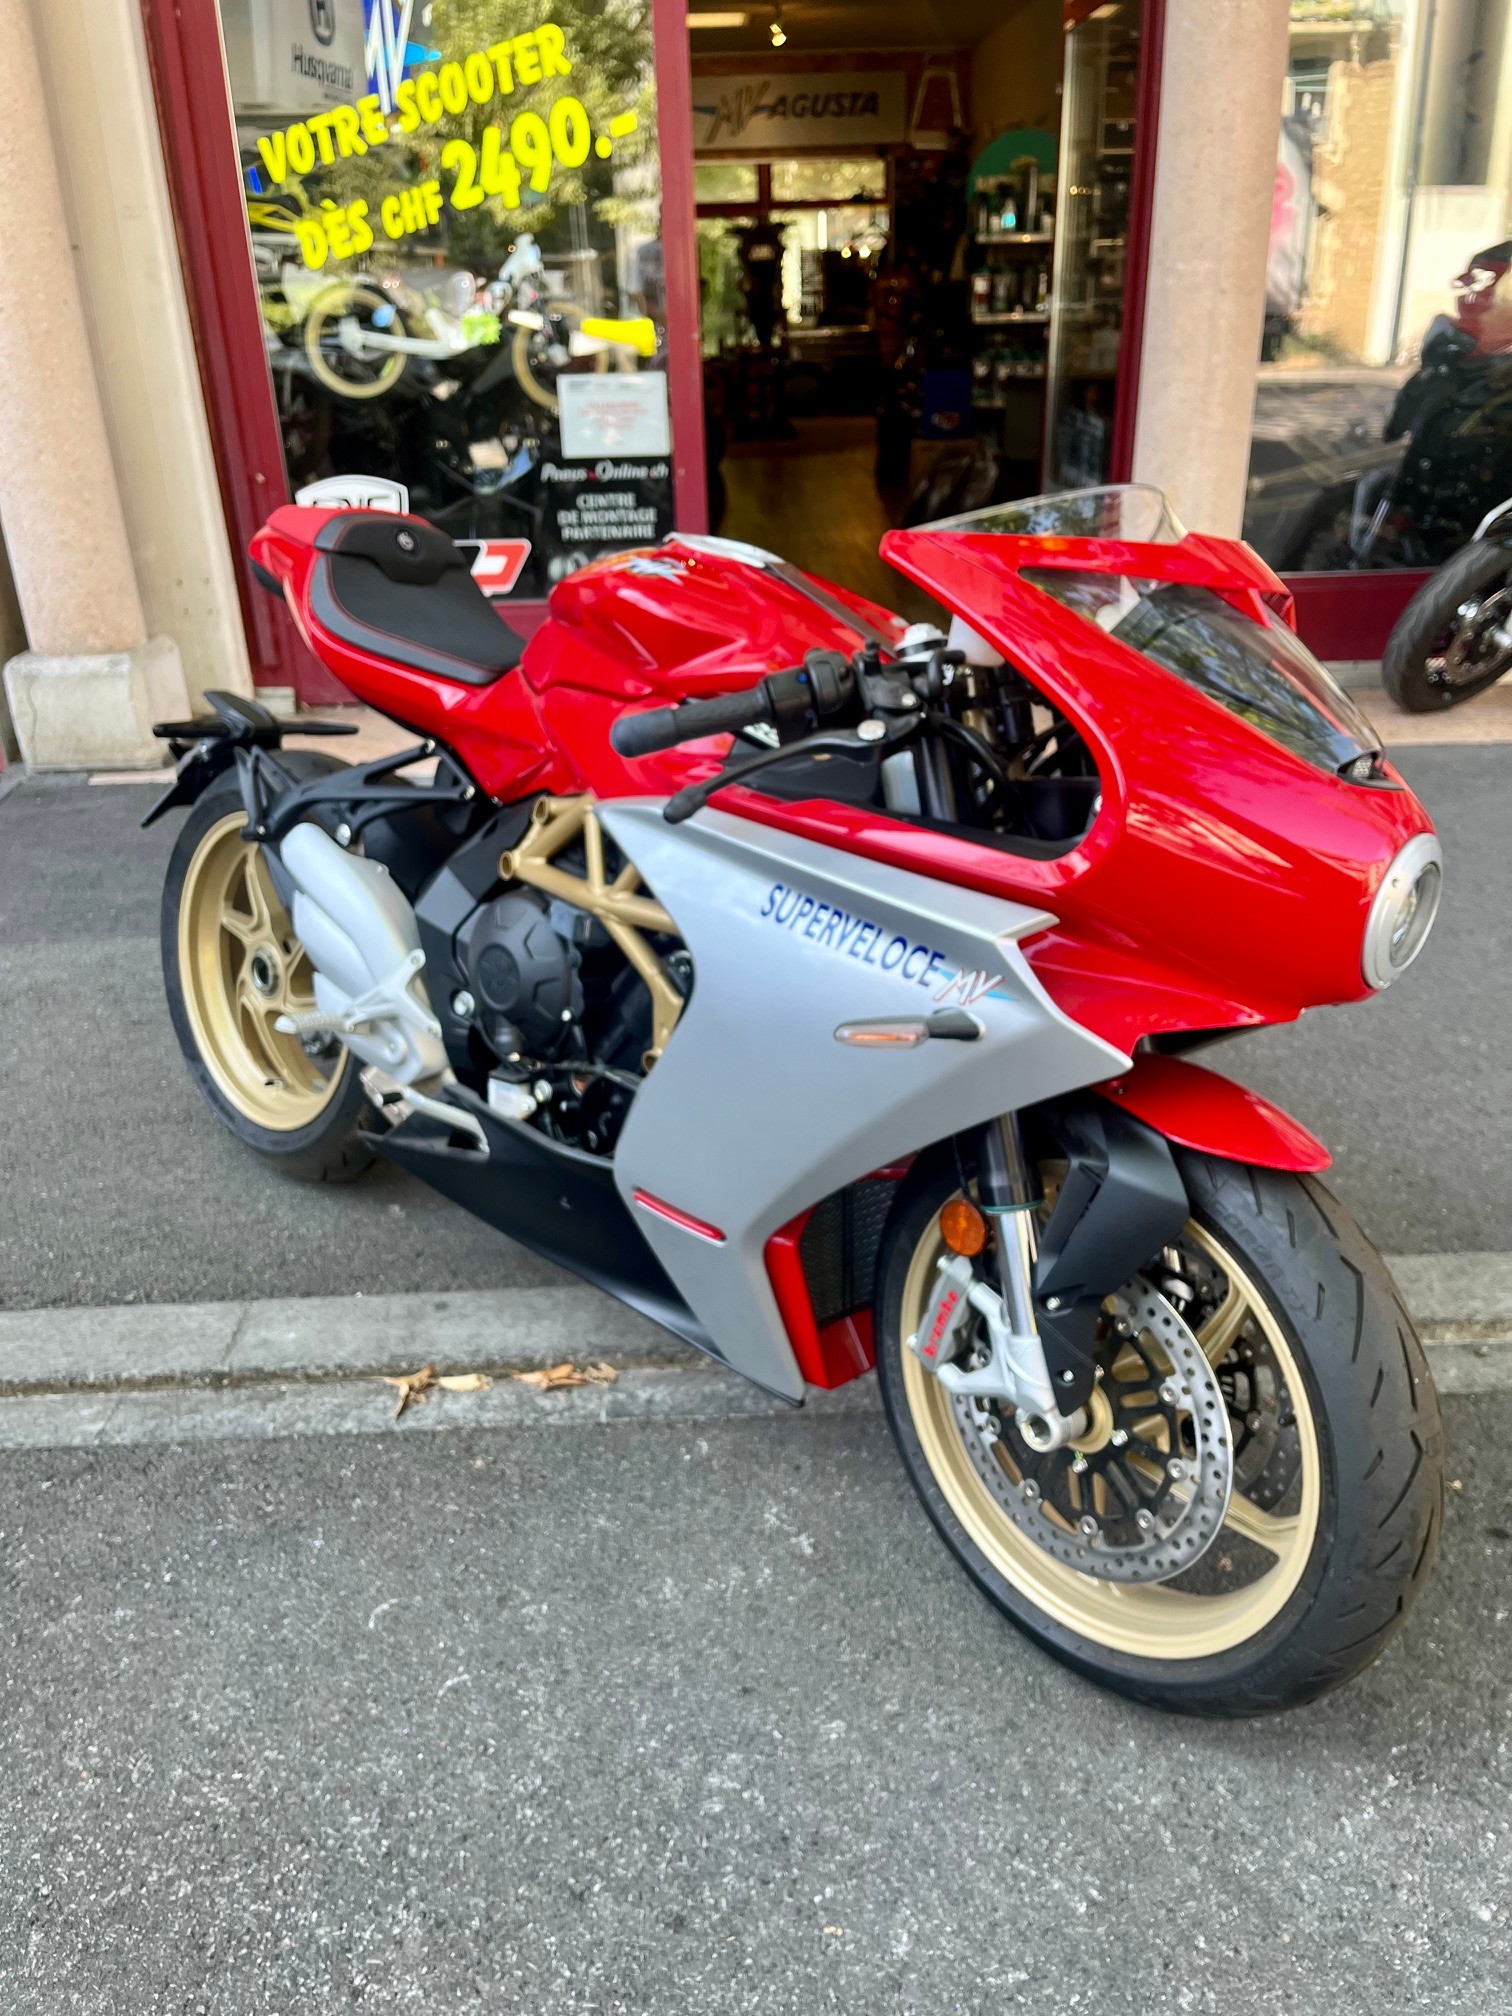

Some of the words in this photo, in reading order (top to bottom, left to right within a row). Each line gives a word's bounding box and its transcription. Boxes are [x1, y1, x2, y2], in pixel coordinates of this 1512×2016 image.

[257, 93, 389, 184] VOTRE
[395, 22, 572, 133] SCOOTER
[766, 91, 880, 120] AGUSTA
[294, 198, 374, 270] DÈS
[381, 180, 444, 240] CHF
[556, 509, 579, 527] DE
[580, 507, 658, 524] MONTAGE
[575, 491, 637, 510] CENTRE
[560, 524, 656, 541] PARTENAIRE
[760, 883, 946, 988] SUPERVELOCE
[922, 1289, 959, 1359] brembo
